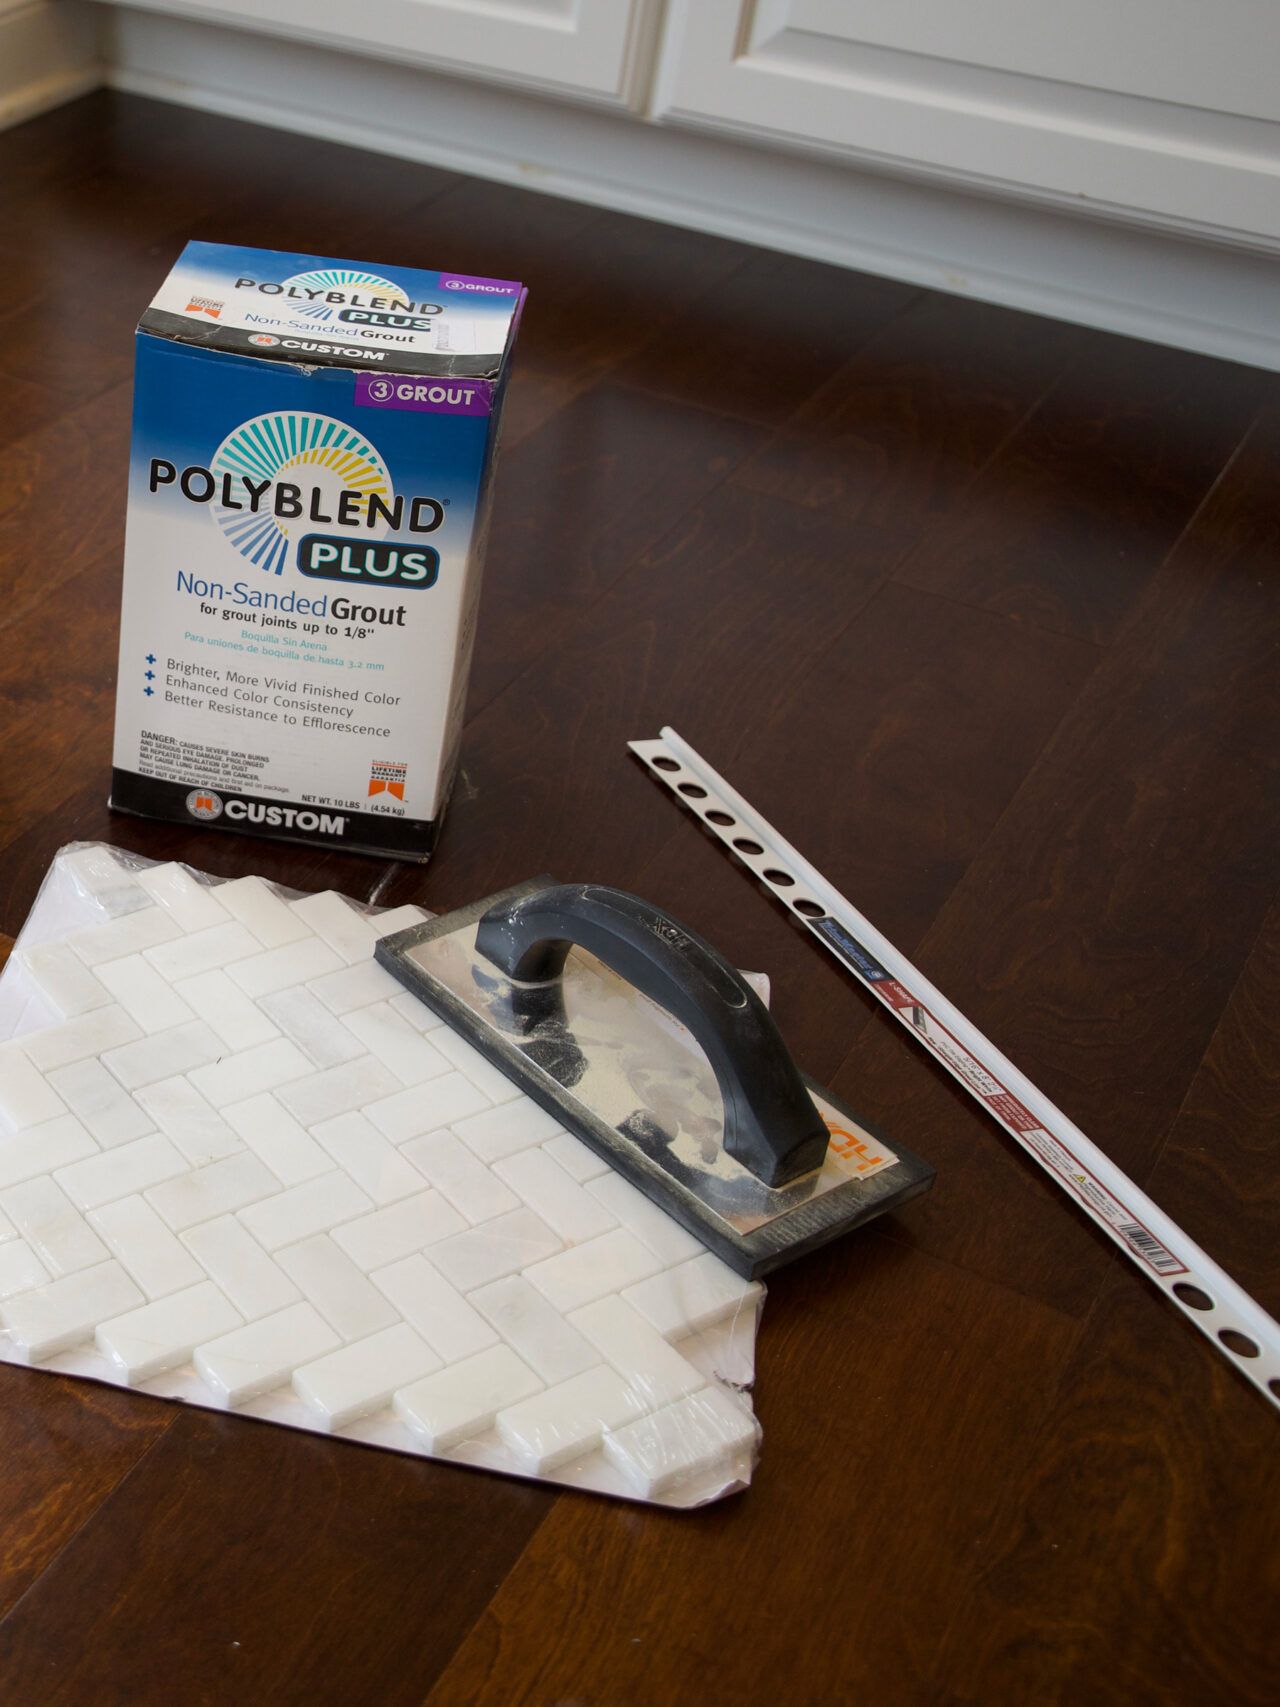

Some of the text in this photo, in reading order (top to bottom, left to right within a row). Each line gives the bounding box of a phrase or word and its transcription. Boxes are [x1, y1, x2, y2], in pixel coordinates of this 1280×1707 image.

[234, 278, 444, 315] POLYBLEND
[466, 283, 514, 294] GROUT
[245, 313, 358, 336] Non-Sanded
[361, 330, 416, 343] Grout
[347, 311, 432, 330] PLUS
[281, 339, 386, 361] CUSTOM
[397, 384, 475, 406] GROUT
[149, 458, 445, 534] POLYBLEND
[310, 542, 428, 581] PLUS
[177, 570, 407, 627] Non-Sanded Grout
[200, 602, 375, 640] for grout joints up to 1/8"
[184, 631, 384, 671] Para uniones de boquilla de hasta 3.2 mm
[241, 629, 327, 651] Boquilla Sin Arena
[166, 674, 354, 719] Enhanced Color Consistency
[167, 658, 401, 706] Brighter, More Vivid Finished Color
[164, 690, 391, 738] Better Resistance to Efflorescence
[140, 739, 153, 747] AND
[155, 742, 181, 753] SERIOUS
[226, 757, 264, 769] PROLONGED
[141, 730, 270, 763] DANGER: CAUSES SEVERE SKIN BURNS
[150, 747, 181, 760] REPEATED
[182, 754, 219, 768] INHALATION
[231, 764, 248, 772] DUST
[140, 752, 153, 760] MAY
[154, 755, 174, 766] CAUSE
[176, 761, 192, 769] LUNG
[194, 764, 221, 775] DAMAGE
[371, 766, 406, 774] LIFETIME
[139, 766, 154, 775] KEEP
[155, 770, 167, 778] OUT
[179, 775, 199, 785] REACH
[210, 781, 242, 792] CHILDREN
[224, 799, 345, 835] CUSTOM
[301, 794, 405, 816] NET WT. 10 LBS (4.54 kg)
